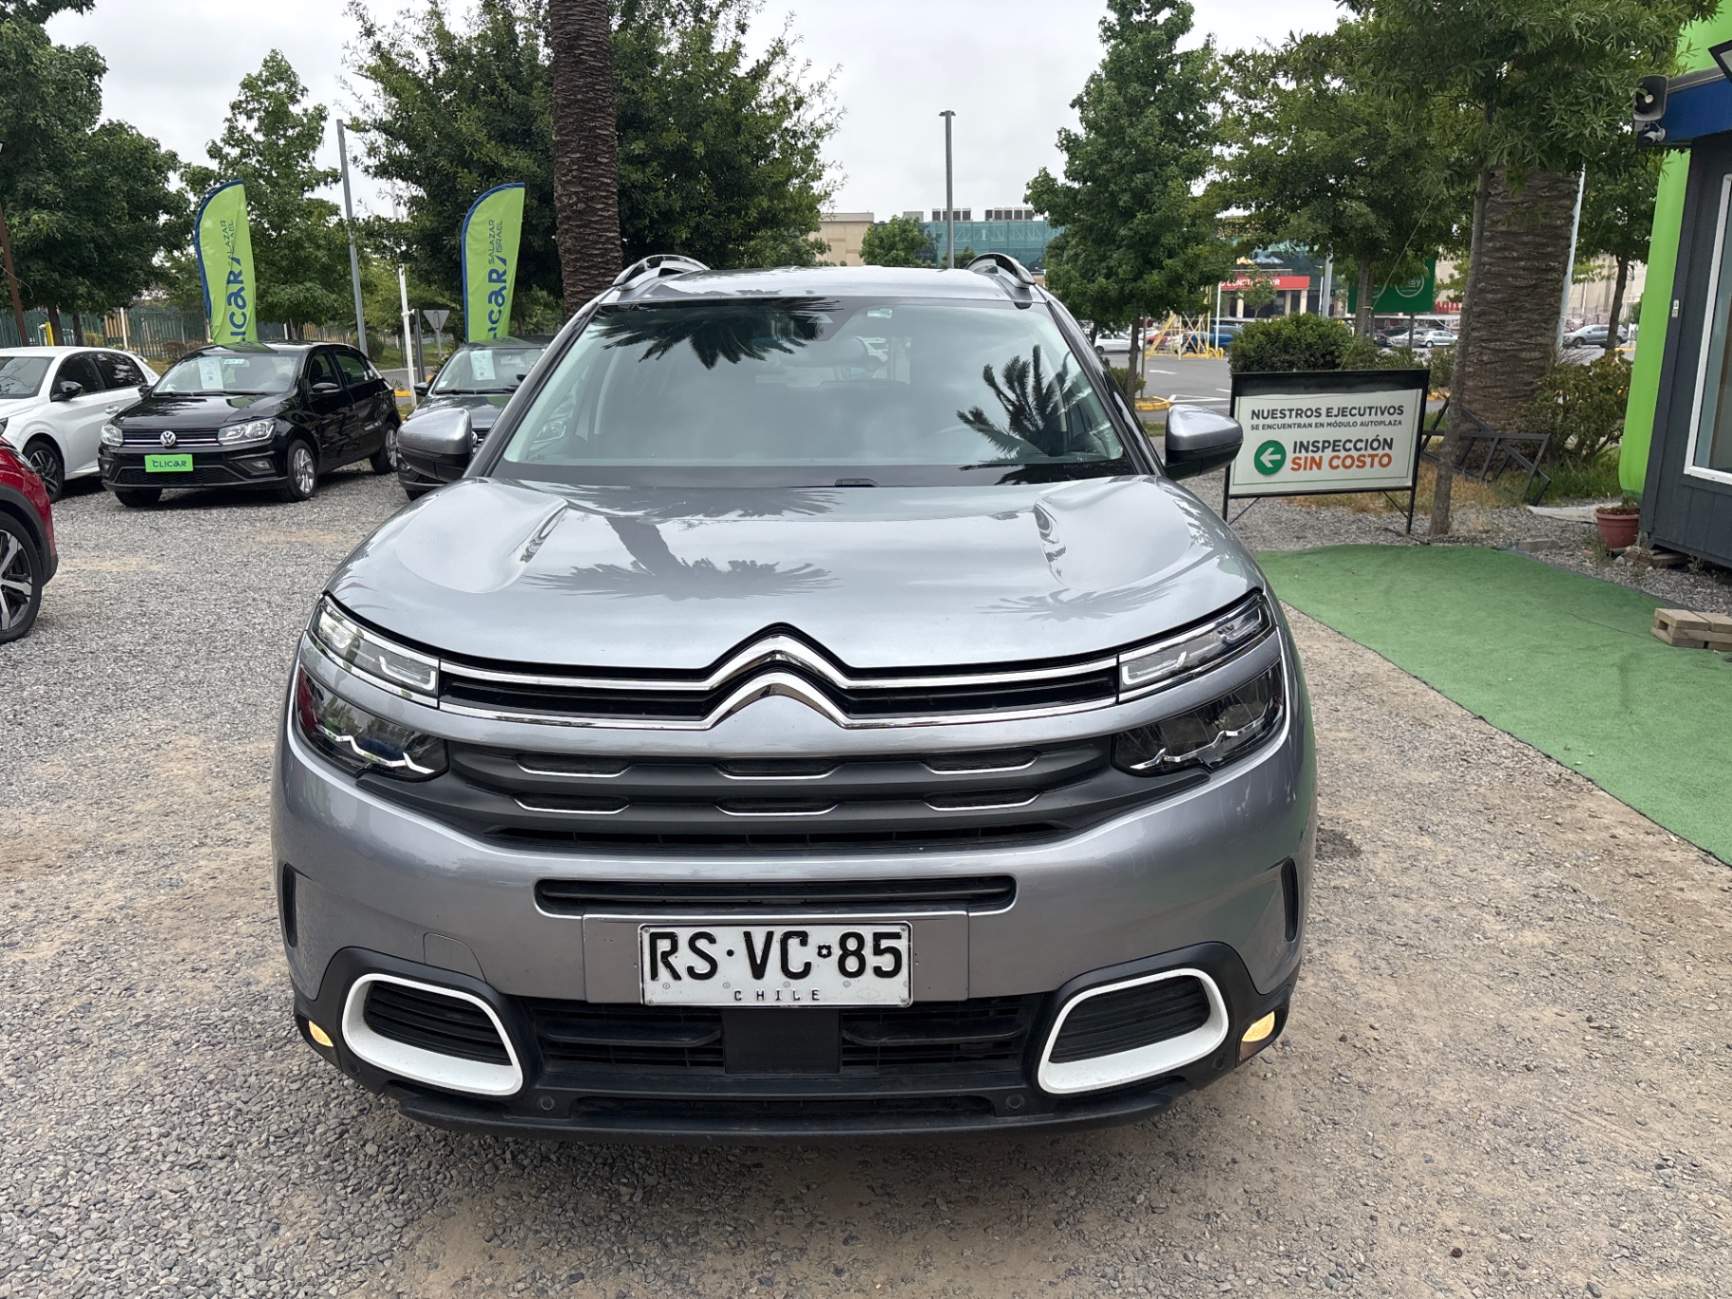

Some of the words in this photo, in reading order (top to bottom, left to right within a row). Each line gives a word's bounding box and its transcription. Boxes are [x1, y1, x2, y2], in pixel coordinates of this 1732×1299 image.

[1250, 407, 1322, 420] NUESTROS
[1326, 405, 1404, 418] EJECUTIVOS
[1250, 423, 1260, 431] SE
[1261, 422, 1313, 431] ENCUENTRAN
[1314, 421, 1325, 429] EN
[1326, 420, 1358, 428] MÓDULO
[1360, 419, 1402, 427] AUTOPLAZA
[1292, 434, 1394, 454] INSPECCIÓN
[1290, 455, 1323, 472] SIN
[1328, 452, 1393, 470] COSTO
[733, 989, 821, 1001] CHILE
